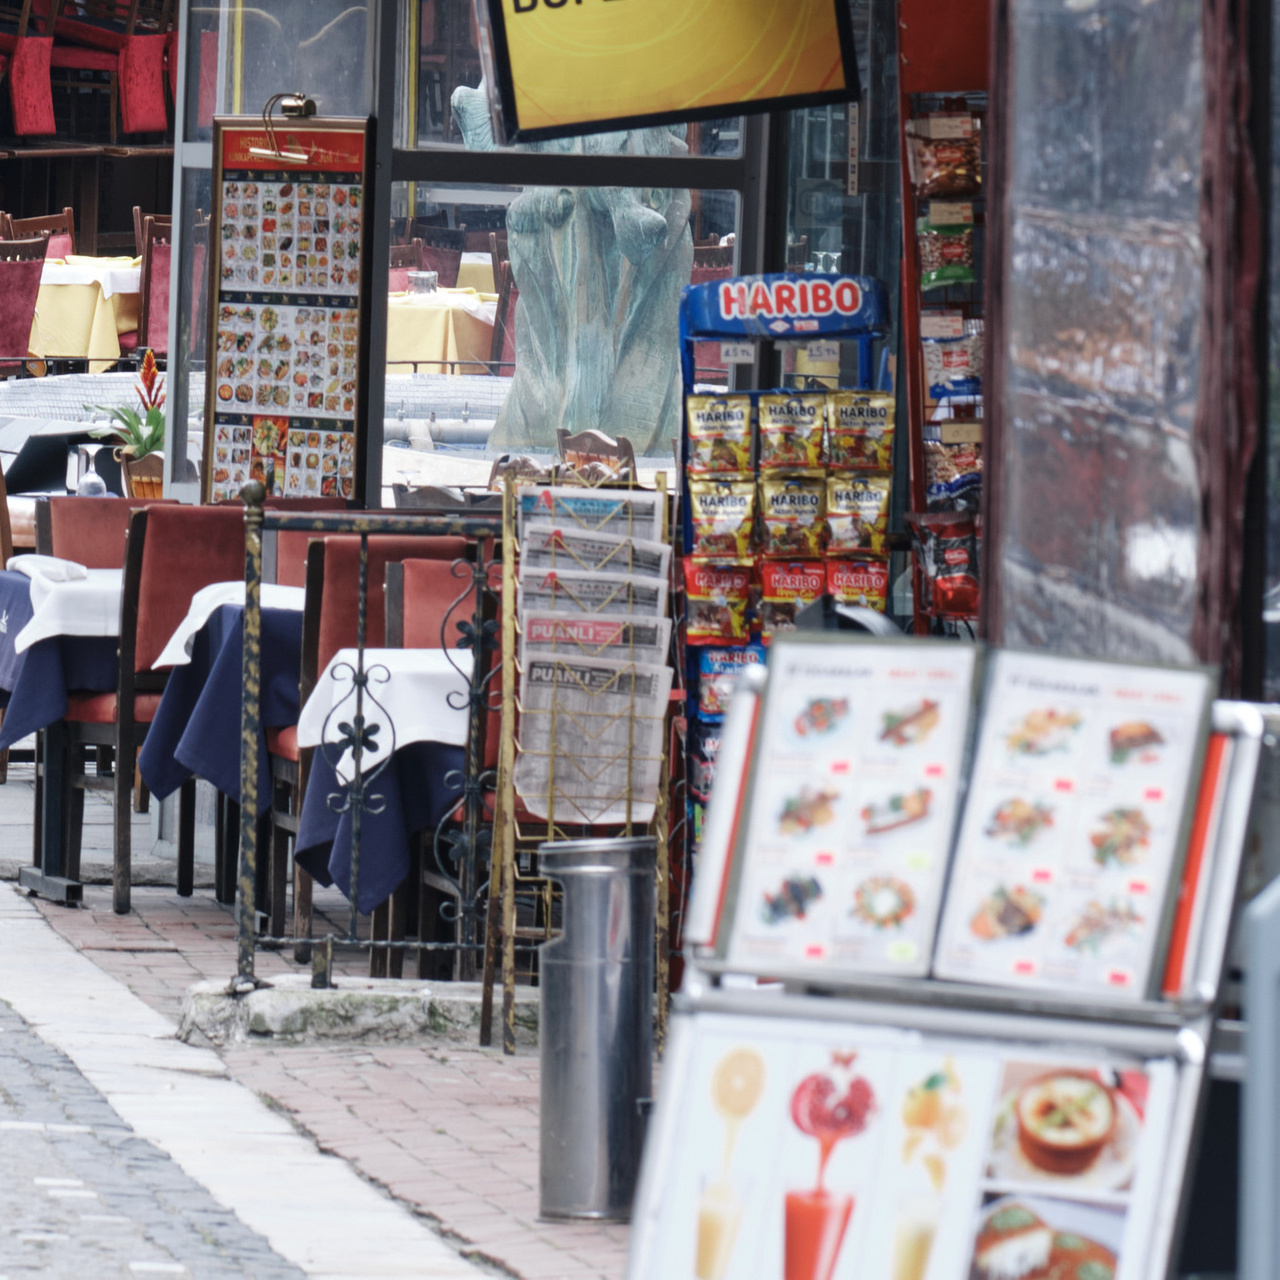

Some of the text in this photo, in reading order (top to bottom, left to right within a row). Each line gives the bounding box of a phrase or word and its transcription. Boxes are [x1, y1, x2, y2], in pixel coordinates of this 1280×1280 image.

[721, 280, 861, 317] HARIBO
[696, 411, 744, 421] HARIBO
[770, 405, 816, 416] HARIBO
[840, 407, 887, 418] HARIBO
[699, 496, 747, 507] HARIBO
[771, 495, 818, 506] HARIBO
[772, 574, 820, 589] HARIBO
[834, 573, 884, 588] HARIBO
[532, 625, 594, 640] PUANLI
[709, 652, 758, 664] HARIBO
